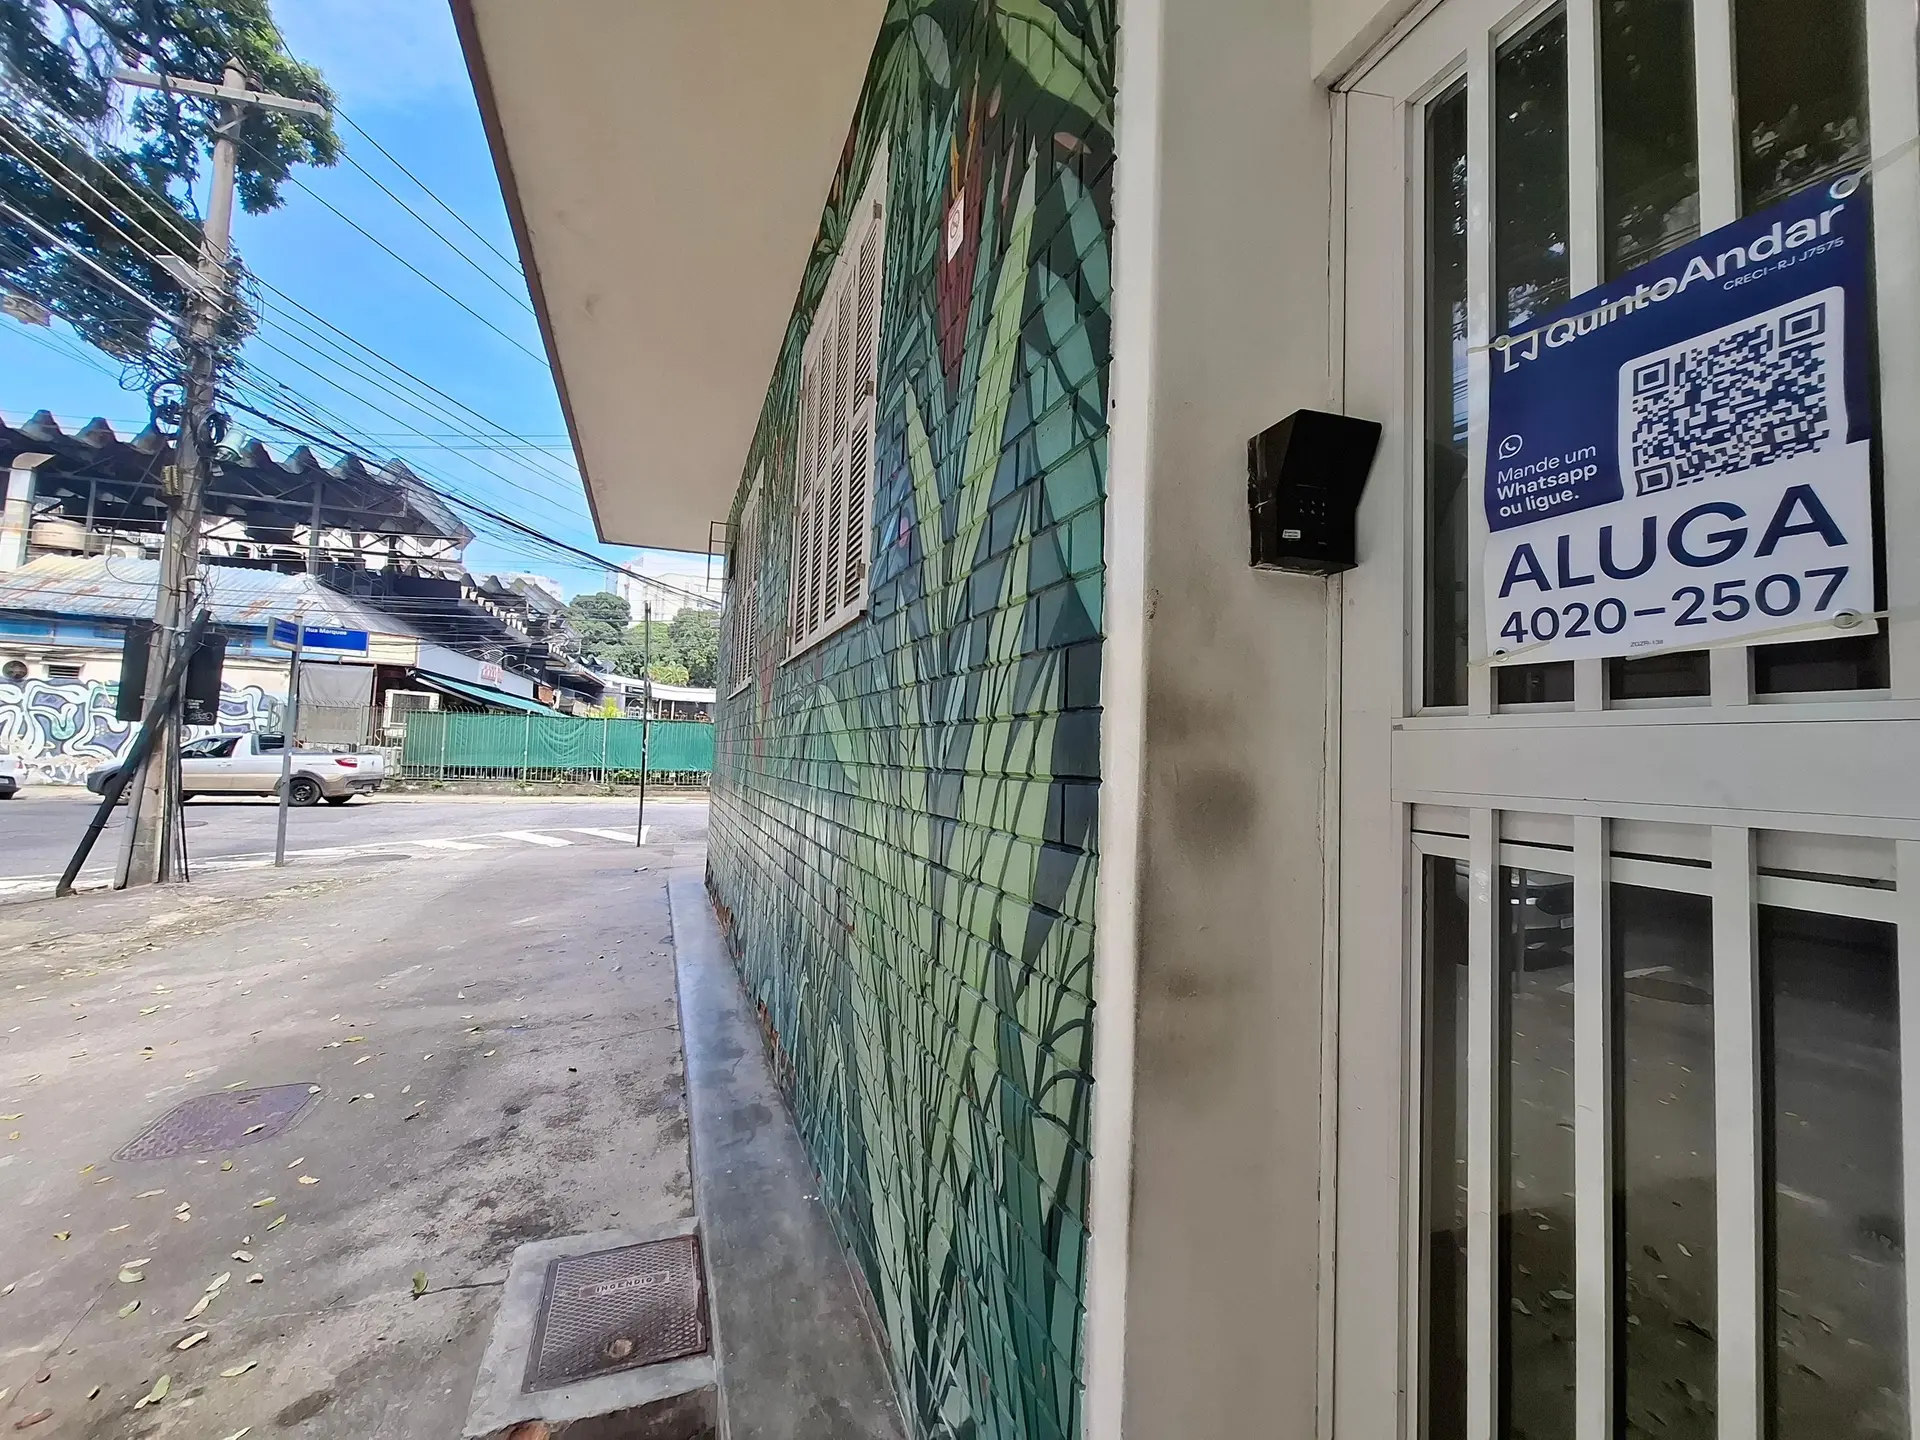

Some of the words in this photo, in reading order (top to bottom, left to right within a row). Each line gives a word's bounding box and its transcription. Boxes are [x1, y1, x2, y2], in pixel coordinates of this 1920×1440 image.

[1545, 204, 1845, 348] QuintoAndar
[1722, 255, 1796, 291] CRECI-RJ
[1798, 236, 1845, 263] J7575
[1496, 464, 1598, 501] Whatsapp
[1498, 456, 1560, 485] Mande
[1564, 445, 1596, 464] um
[1499, 502, 1523, 518] ou
[1525, 489, 1580, 512] ligue.
[1498, 483, 1849, 599] ALUGA
[1499, 566, 1850, 644] 4020-2507
